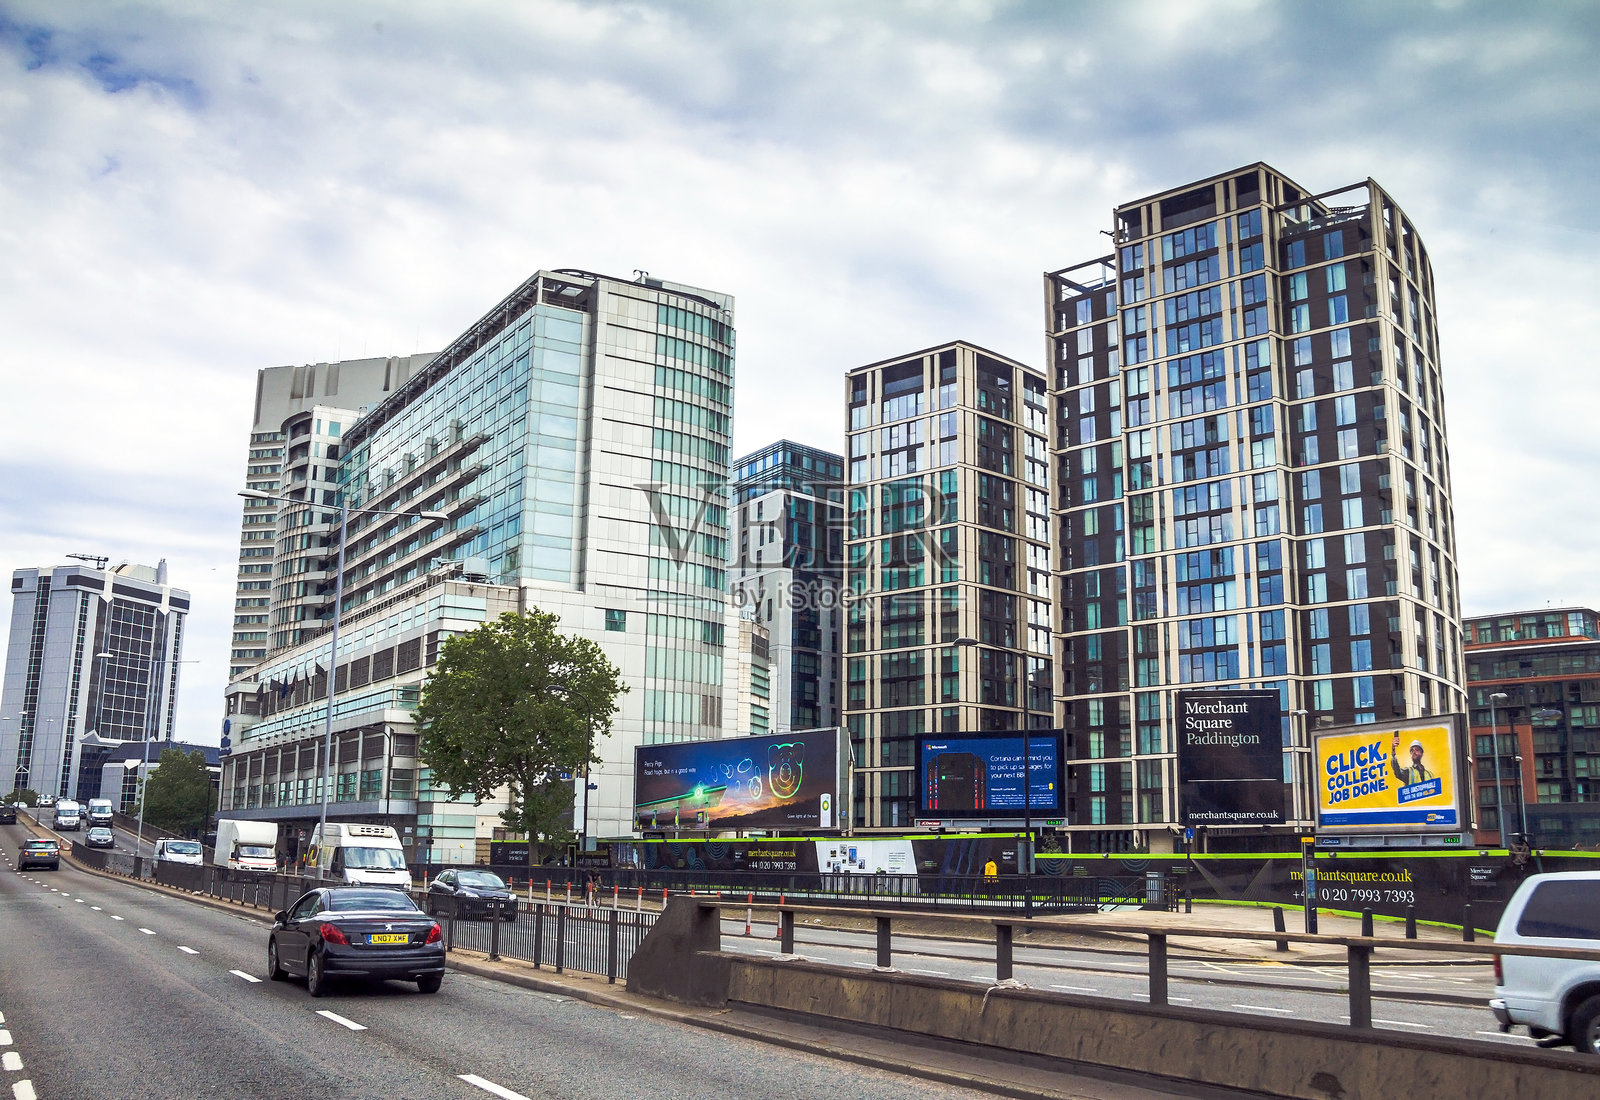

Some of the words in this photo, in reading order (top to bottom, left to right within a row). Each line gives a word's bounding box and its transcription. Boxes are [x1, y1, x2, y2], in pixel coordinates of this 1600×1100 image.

[1185, 701, 1248, 714] Merchant
[1185, 717, 1232, 732] Square
[1186, 732, 1260, 747] Paddington
[1326, 741, 1388, 776] CLICK.
[1327, 762, 1388, 791] COLLECT.
[1328, 788, 1350, 805] JOB
[1352, 779, 1388, 798] DONE.
[1189, 810, 1279, 820] merchantsquare.co.uk
[771, 861, 784, 870] 7993
[1290, 868, 1412, 884] mehantsquare.co.uk
[1351, 889, 1381, 902] 7993
[1384, 889, 1414, 903] 7393
